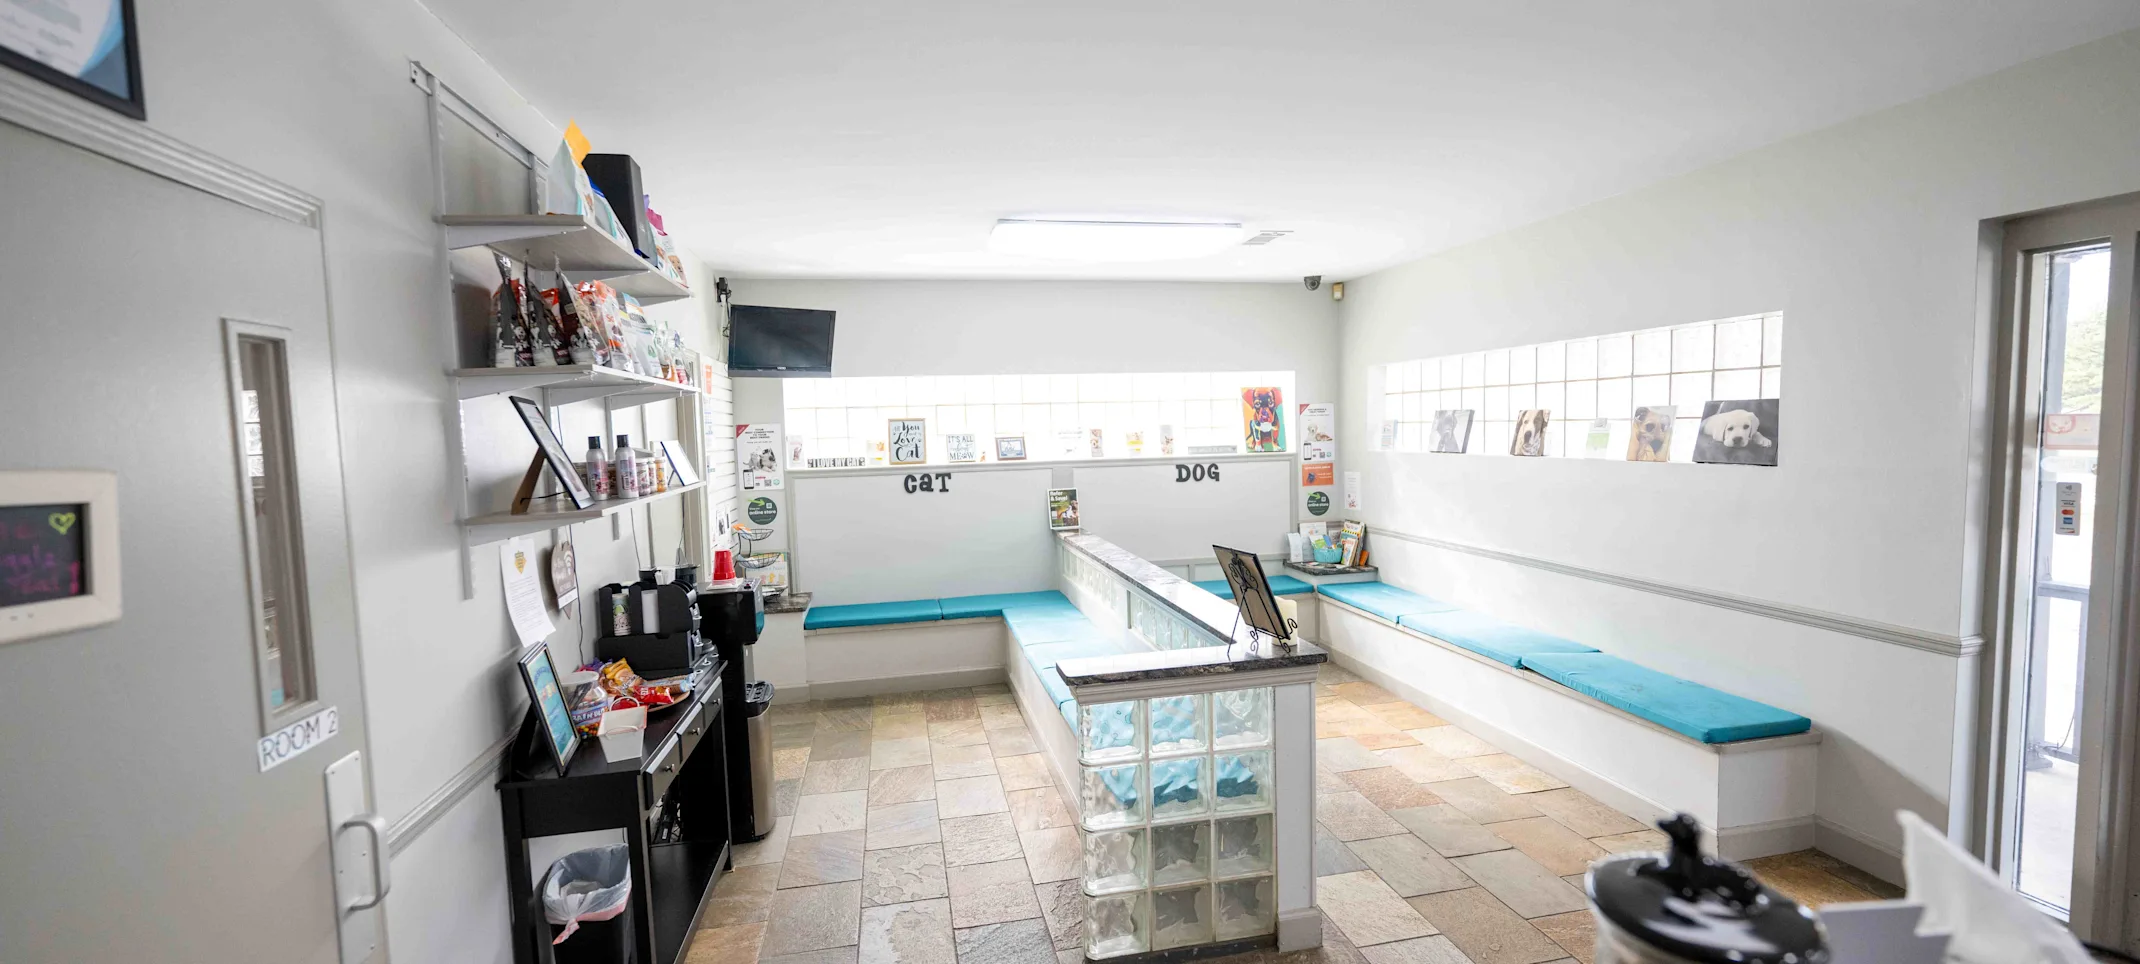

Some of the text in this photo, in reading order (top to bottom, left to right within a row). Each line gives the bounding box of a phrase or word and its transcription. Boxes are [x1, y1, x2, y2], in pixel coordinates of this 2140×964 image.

[902, 421, 920, 437] You
[962, 435, 974, 443] ALL
[895, 443, 924, 462] Cat
[817, 458, 835, 468] LOVE
[836, 458, 847, 467] MY
[848, 457, 860, 467] CAT
[1176, 463, 1220, 482] DOG
[261, 710, 337, 766] ROOM 2
